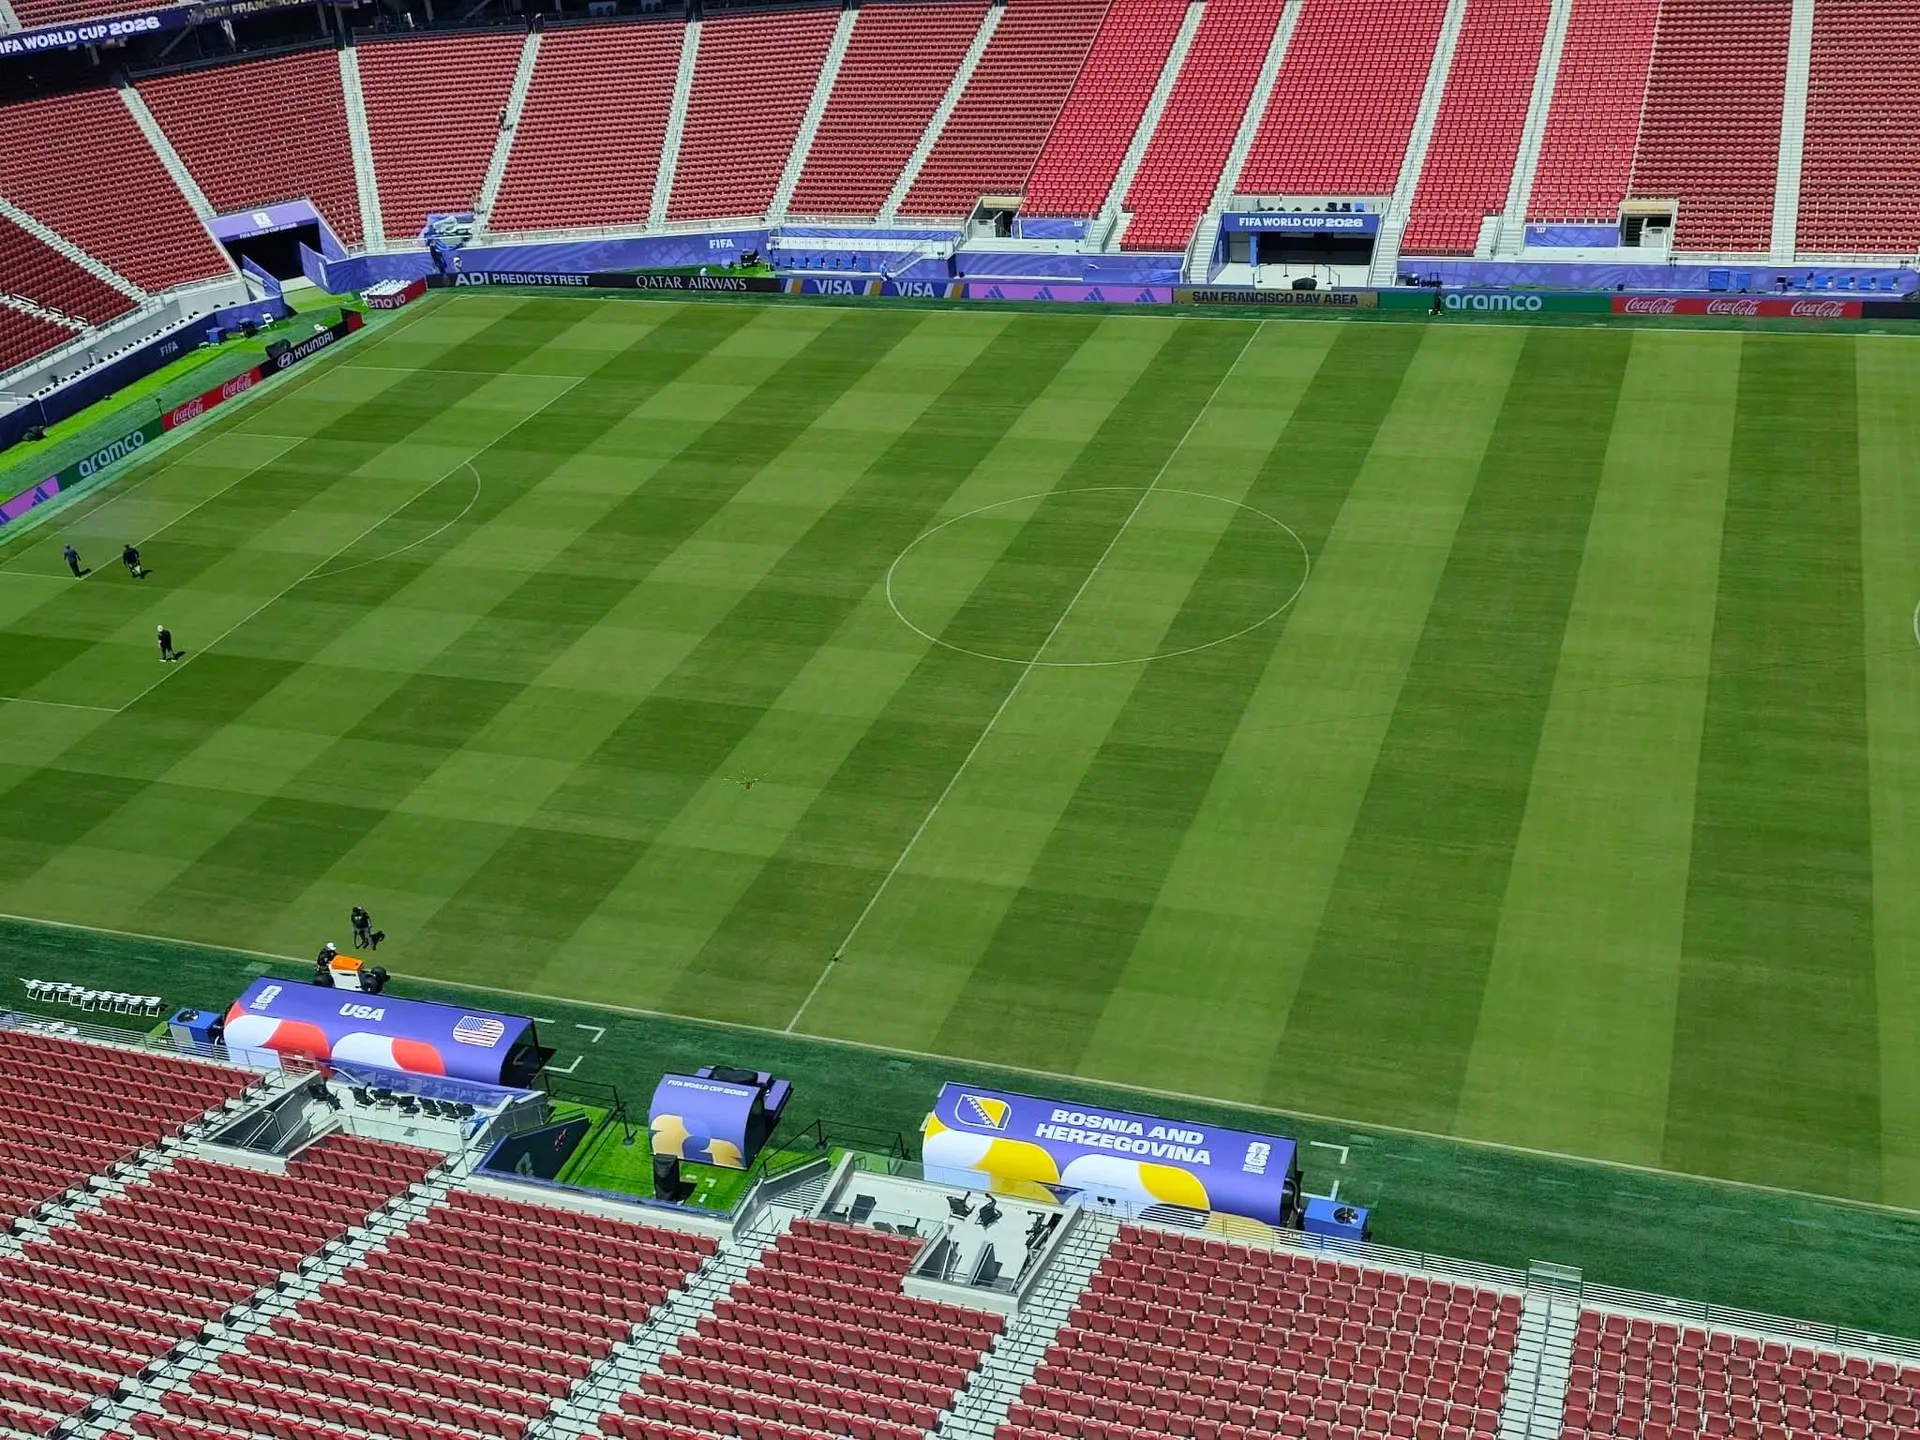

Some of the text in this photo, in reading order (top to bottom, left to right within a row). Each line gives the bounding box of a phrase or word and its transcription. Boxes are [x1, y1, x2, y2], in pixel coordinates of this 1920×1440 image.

[0, 16, 160, 54] IFA WORLD CUP 2026
[1238, 217, 1363, 228] FIFA WORLD CUP 2026
[709, 239, 734, 249] FIFA
[455, 272, 589, 286] ADI PREDICTSTREET
[636, 275, 747, 291] QATAR AIRWAYS
[812, 279, 854, 295] VISA
[894, 281, 935, 298] VISA
[1192, 291, 1358, 305] SAN FRANCISCO BAY AREA
[368, 294, 405, 308] enovo
[1445, 294, 1542, 311] aramco
[159, 340, 179, 357] FIFA
[294, 330, 334, 359] HYUNDAI
[79, 431, 144, 477] aramco
[338, 1003, 386, 1022] USA
[1050, 1109, 1204, 1145] BOSNIA AND
[1035, 1123, 1211, 1166] HERZEGOVINA
